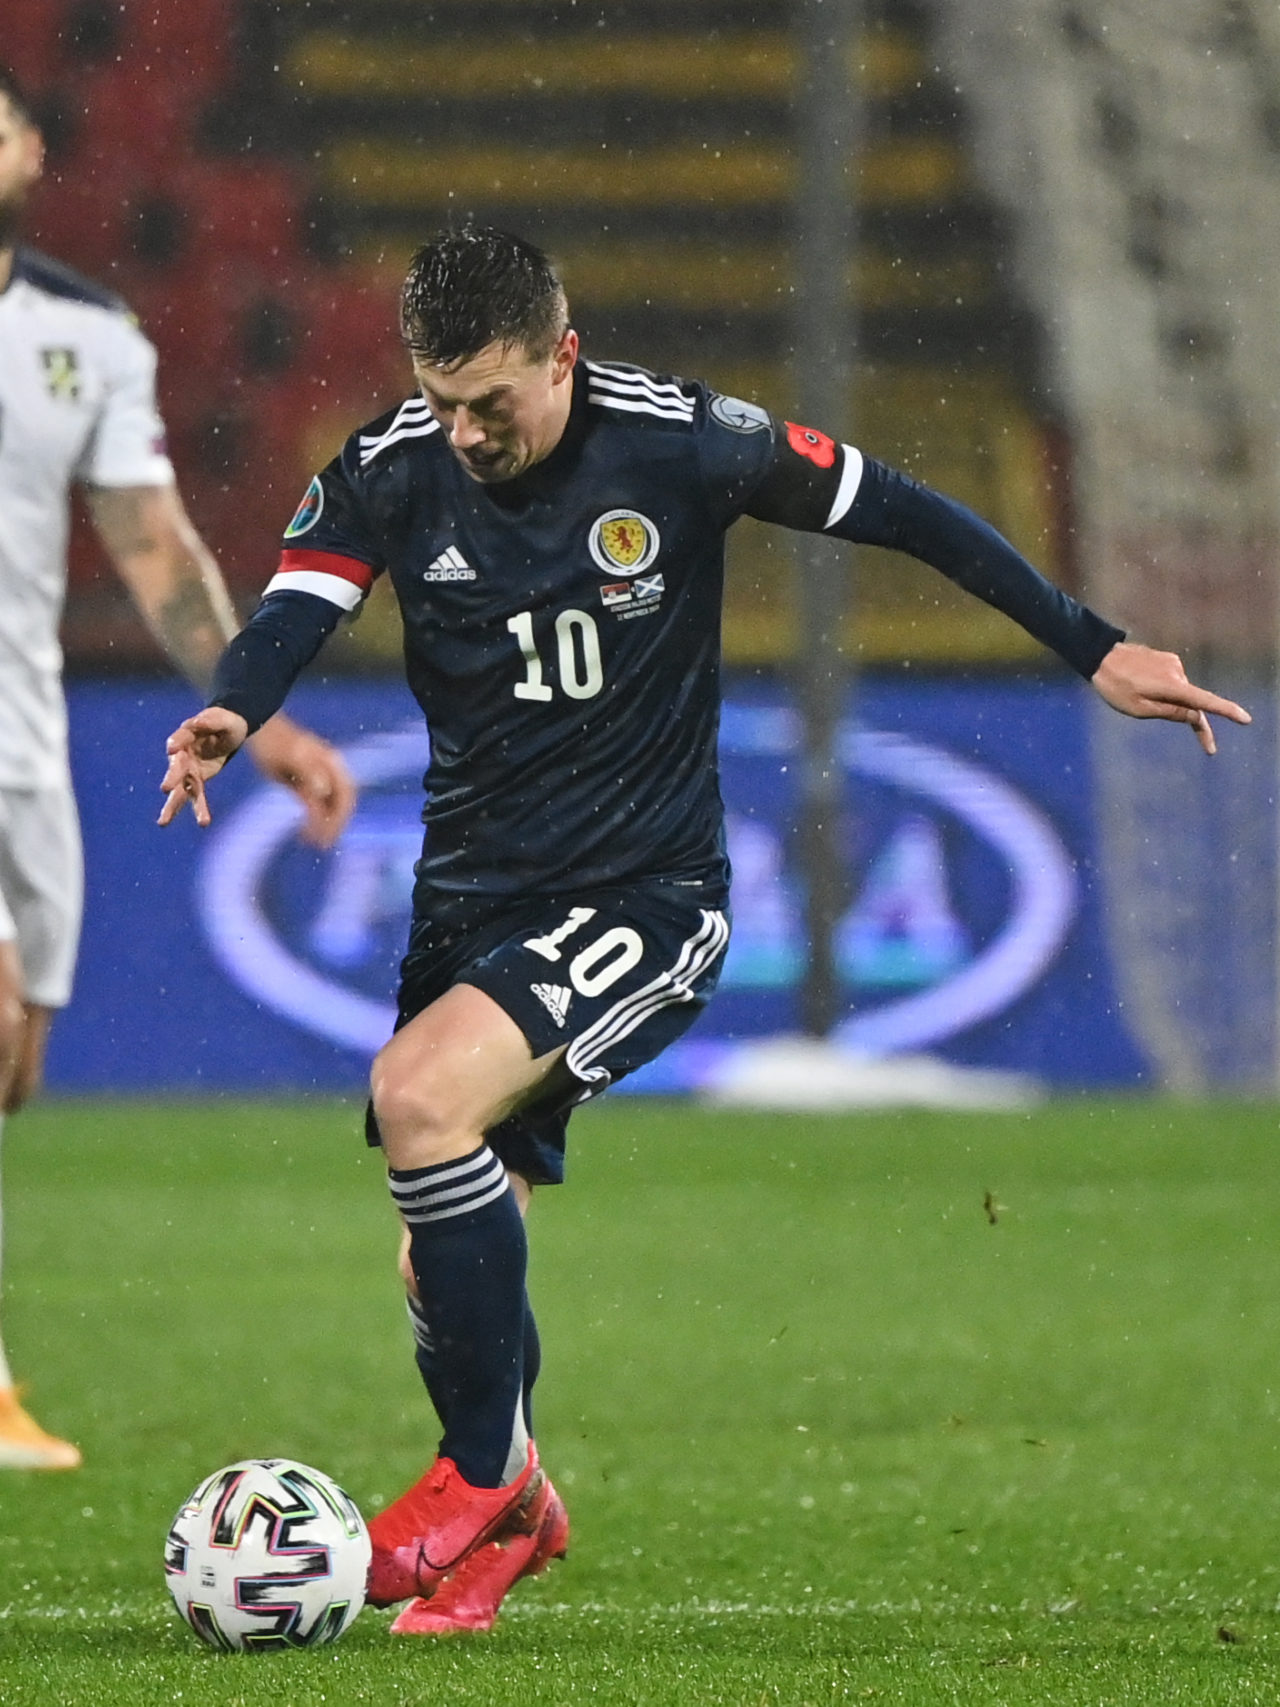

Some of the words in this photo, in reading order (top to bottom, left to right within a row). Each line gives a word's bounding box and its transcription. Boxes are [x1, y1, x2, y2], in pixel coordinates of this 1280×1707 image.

[423, 568, 477, 582] adidas
[506, 608, 604, 702] 10
[522, 906, 644, 998] 10
